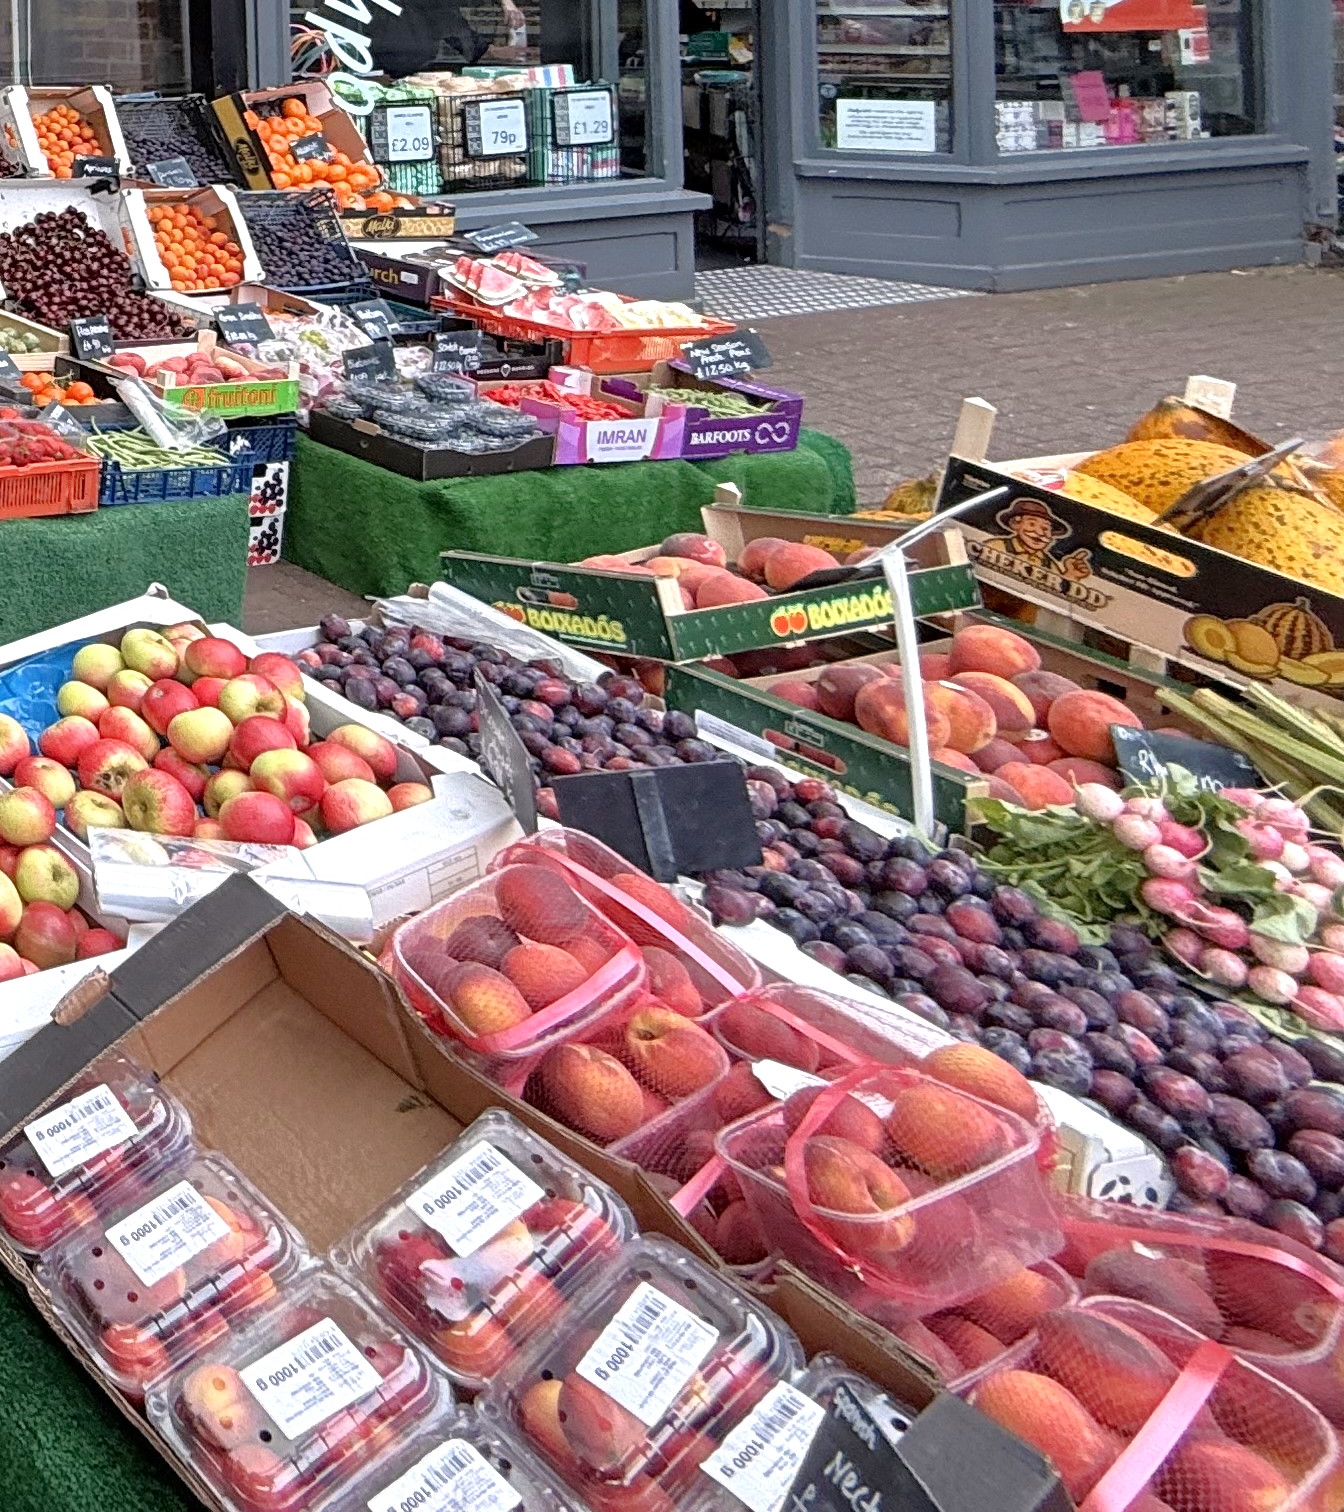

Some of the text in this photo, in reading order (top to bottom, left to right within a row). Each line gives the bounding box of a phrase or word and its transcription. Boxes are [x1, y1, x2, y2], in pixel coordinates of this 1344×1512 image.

[573, 120, 609, 136] £1.29
[391, 137, 430, 153] £2.09
[491, 130, 516, 147] 79p
[596, 428, 647, 445] IMRAN
[689, 428, 752, 445] BARFOOTS
[967, 537, 1062, 589] CHEKER
[1065, 579, 1109, 609] DD
[434, 1185, 462, 1209] 1000
[609, 1339, 635, 1373] 1000
[269, 1363, 299, 1387] 1000
